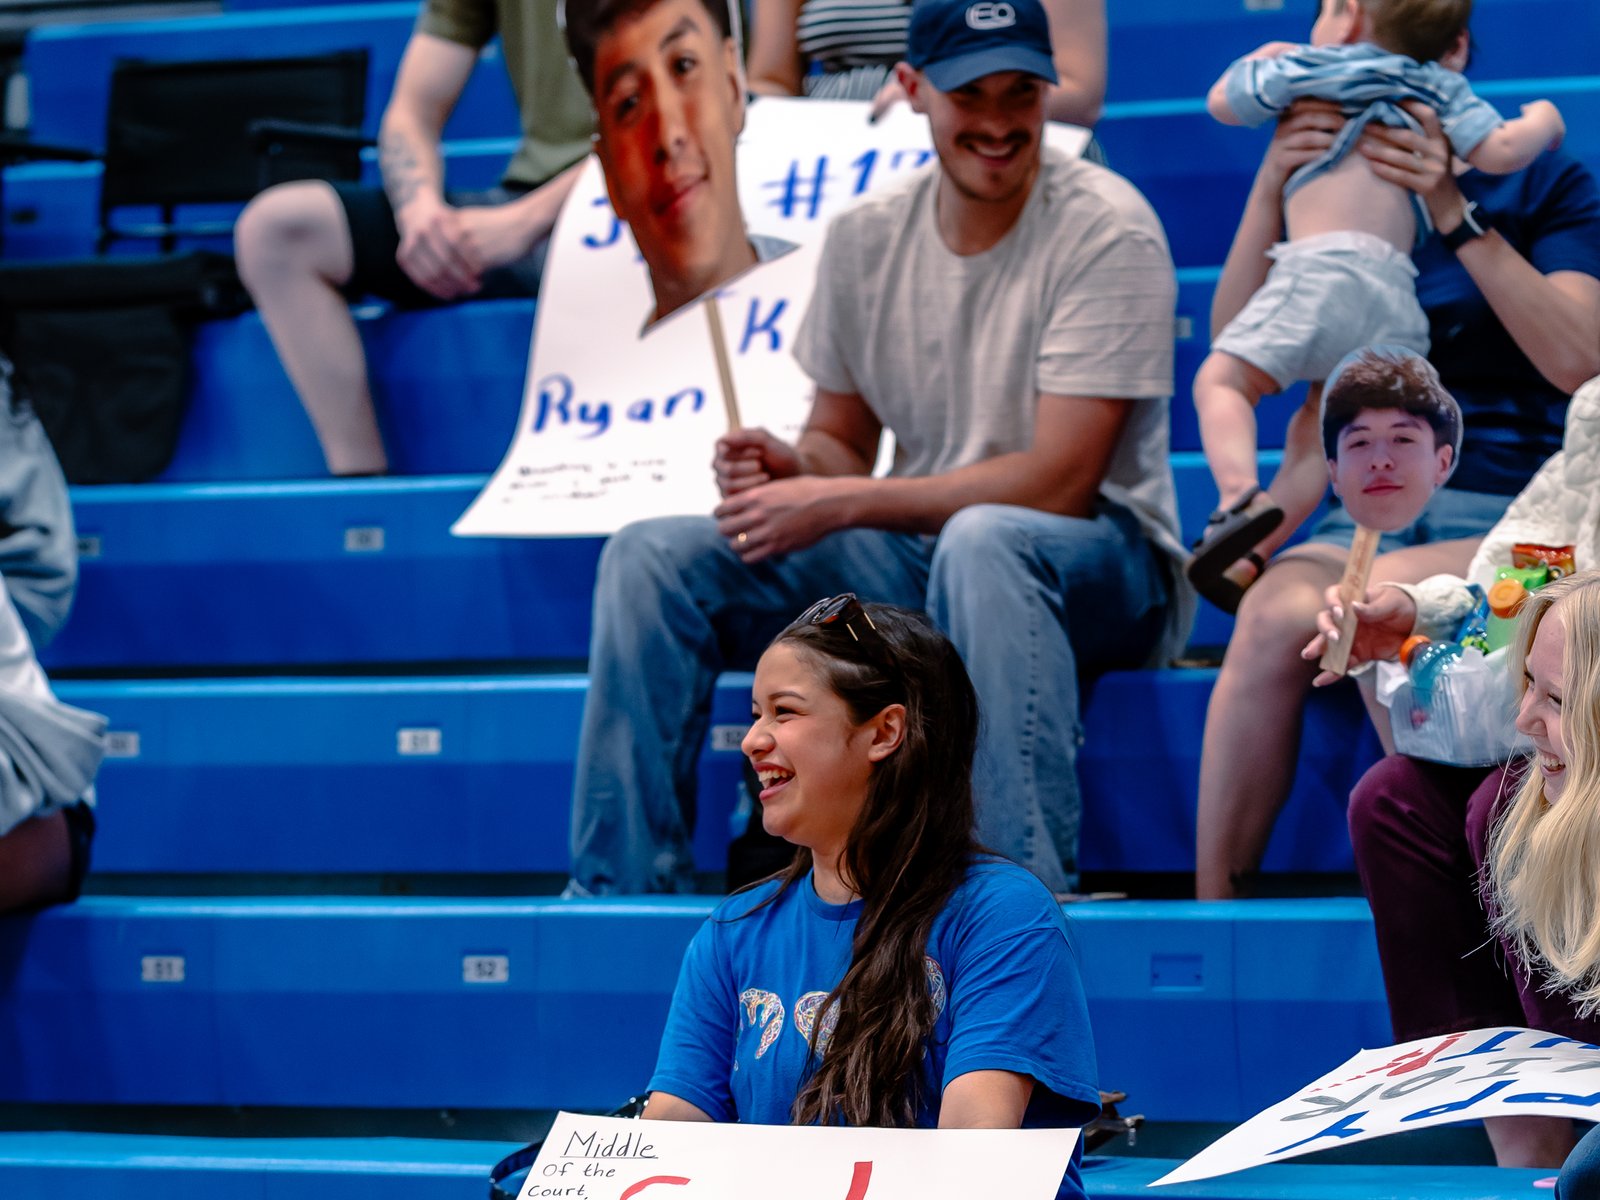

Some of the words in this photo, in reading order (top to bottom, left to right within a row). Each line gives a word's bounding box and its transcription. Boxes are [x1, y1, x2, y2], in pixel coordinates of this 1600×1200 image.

[533, 373, 706, 438] Ryan
[564, 1131, 657, 1158] Middle
[584, 1163, 616, 1177] the
